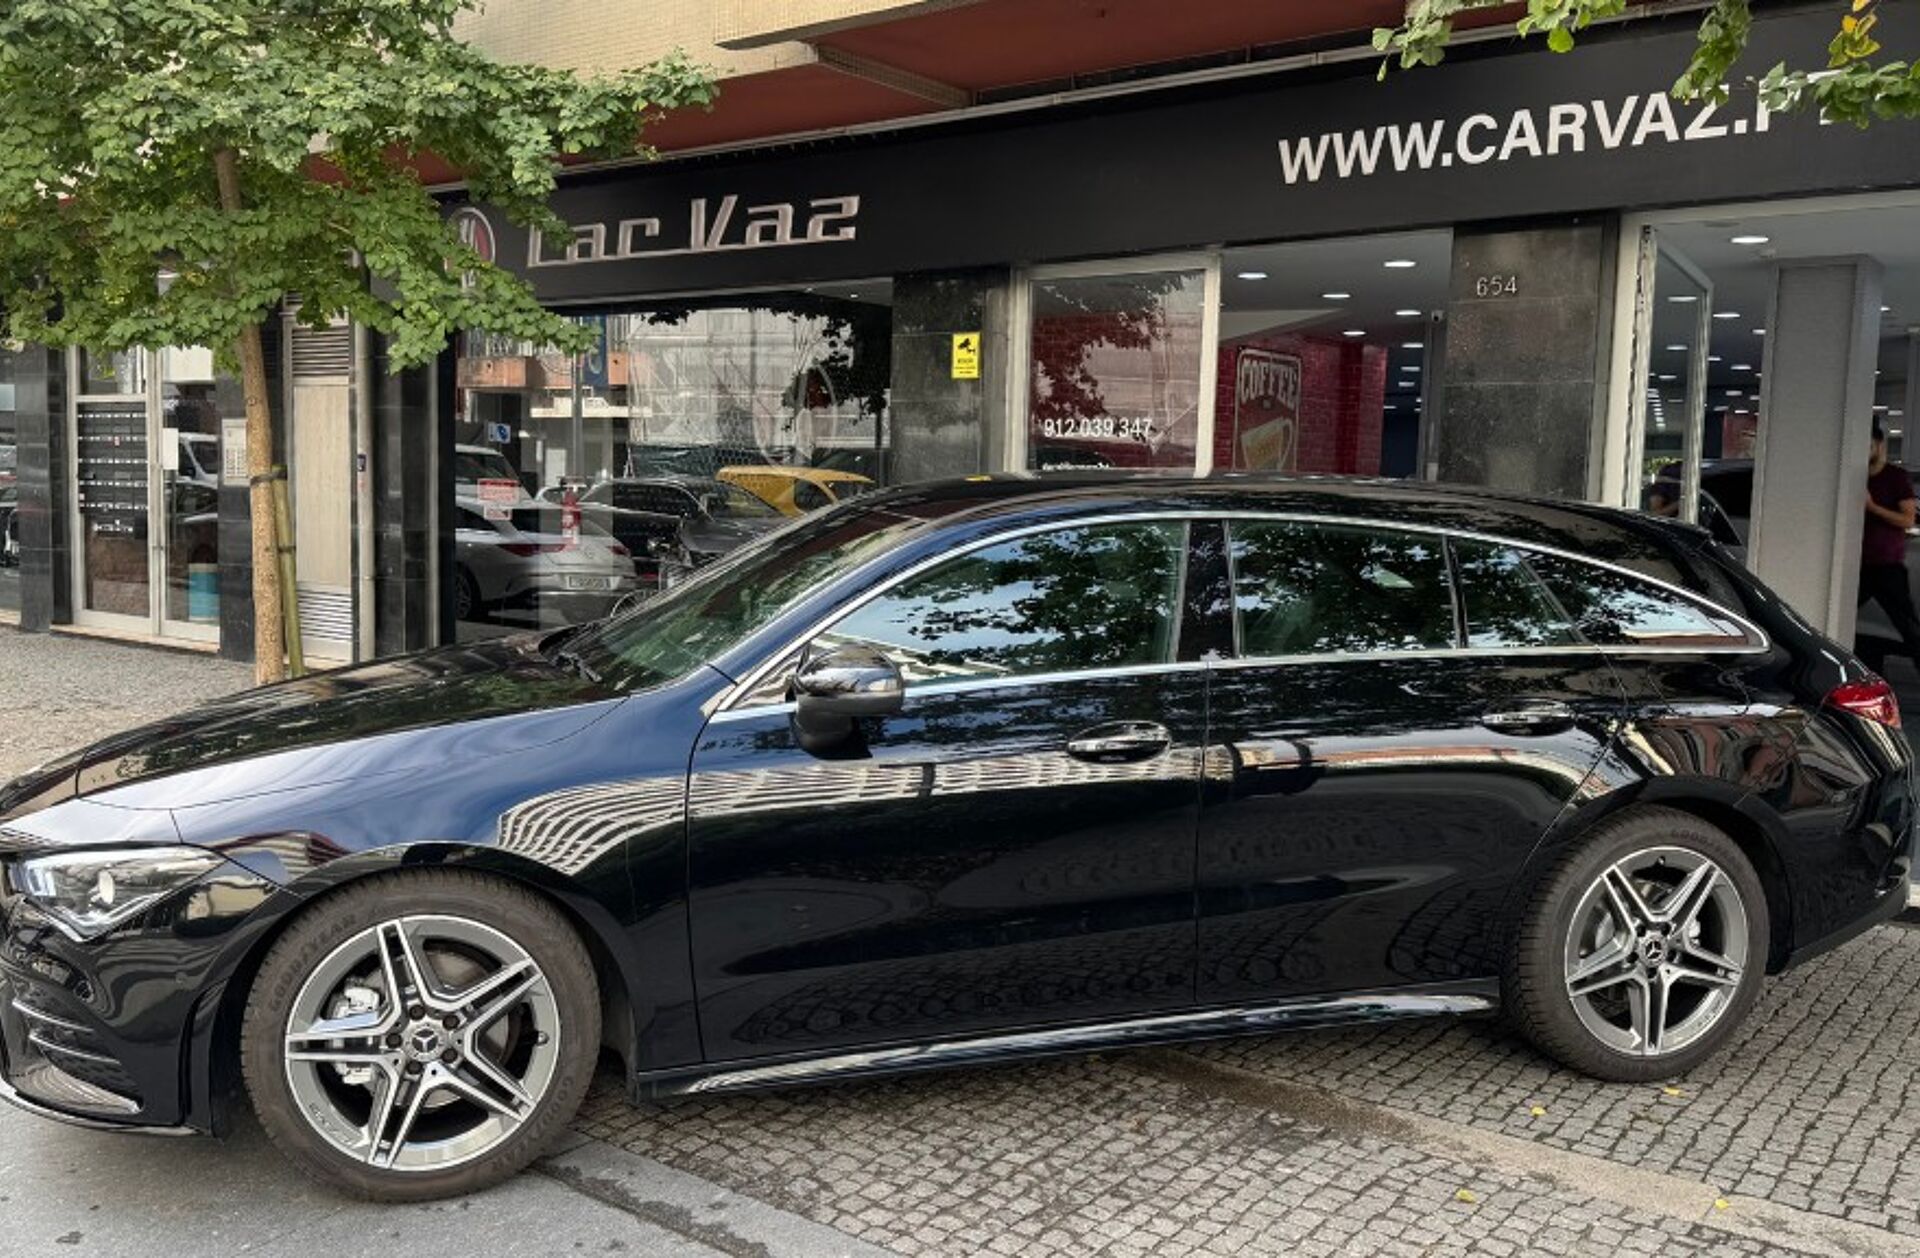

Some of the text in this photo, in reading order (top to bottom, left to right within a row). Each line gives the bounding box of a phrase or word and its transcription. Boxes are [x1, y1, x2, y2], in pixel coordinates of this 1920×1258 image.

[1476, 275, 1517, 297] 654
[1241, 357, 1299, 410] COFFEE
[1043, 417, 1153, 439] 912 039 347
